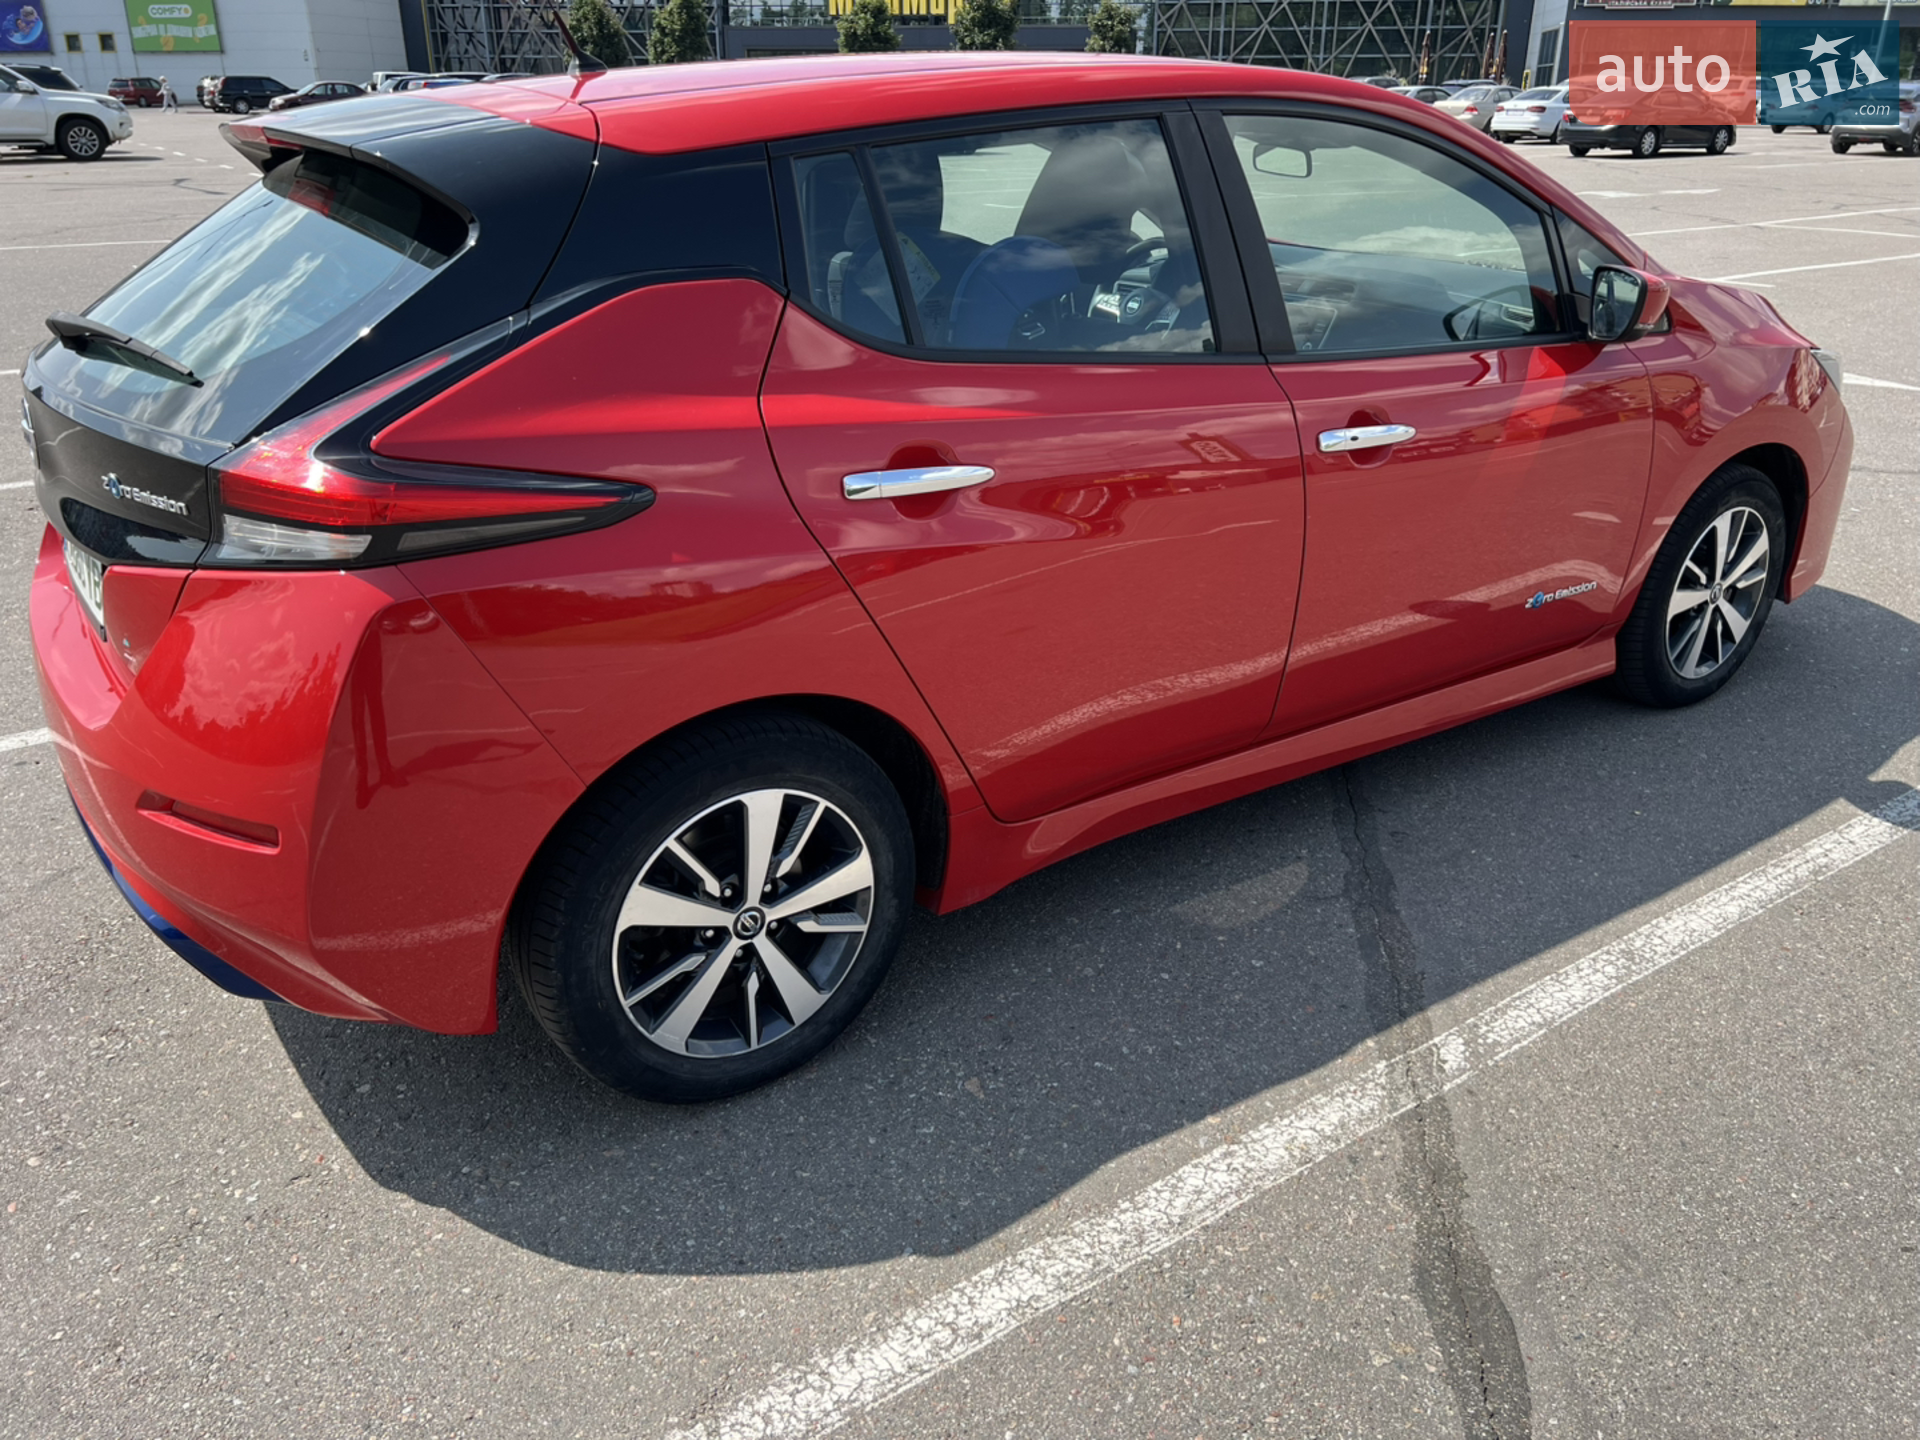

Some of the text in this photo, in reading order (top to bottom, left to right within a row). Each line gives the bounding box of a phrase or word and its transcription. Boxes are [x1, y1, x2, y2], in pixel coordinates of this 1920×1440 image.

[151, 7, 183, 15] COMFY
[131, 487, 188, 516] Emission
[1554, 580, 1597, 600] Emission
